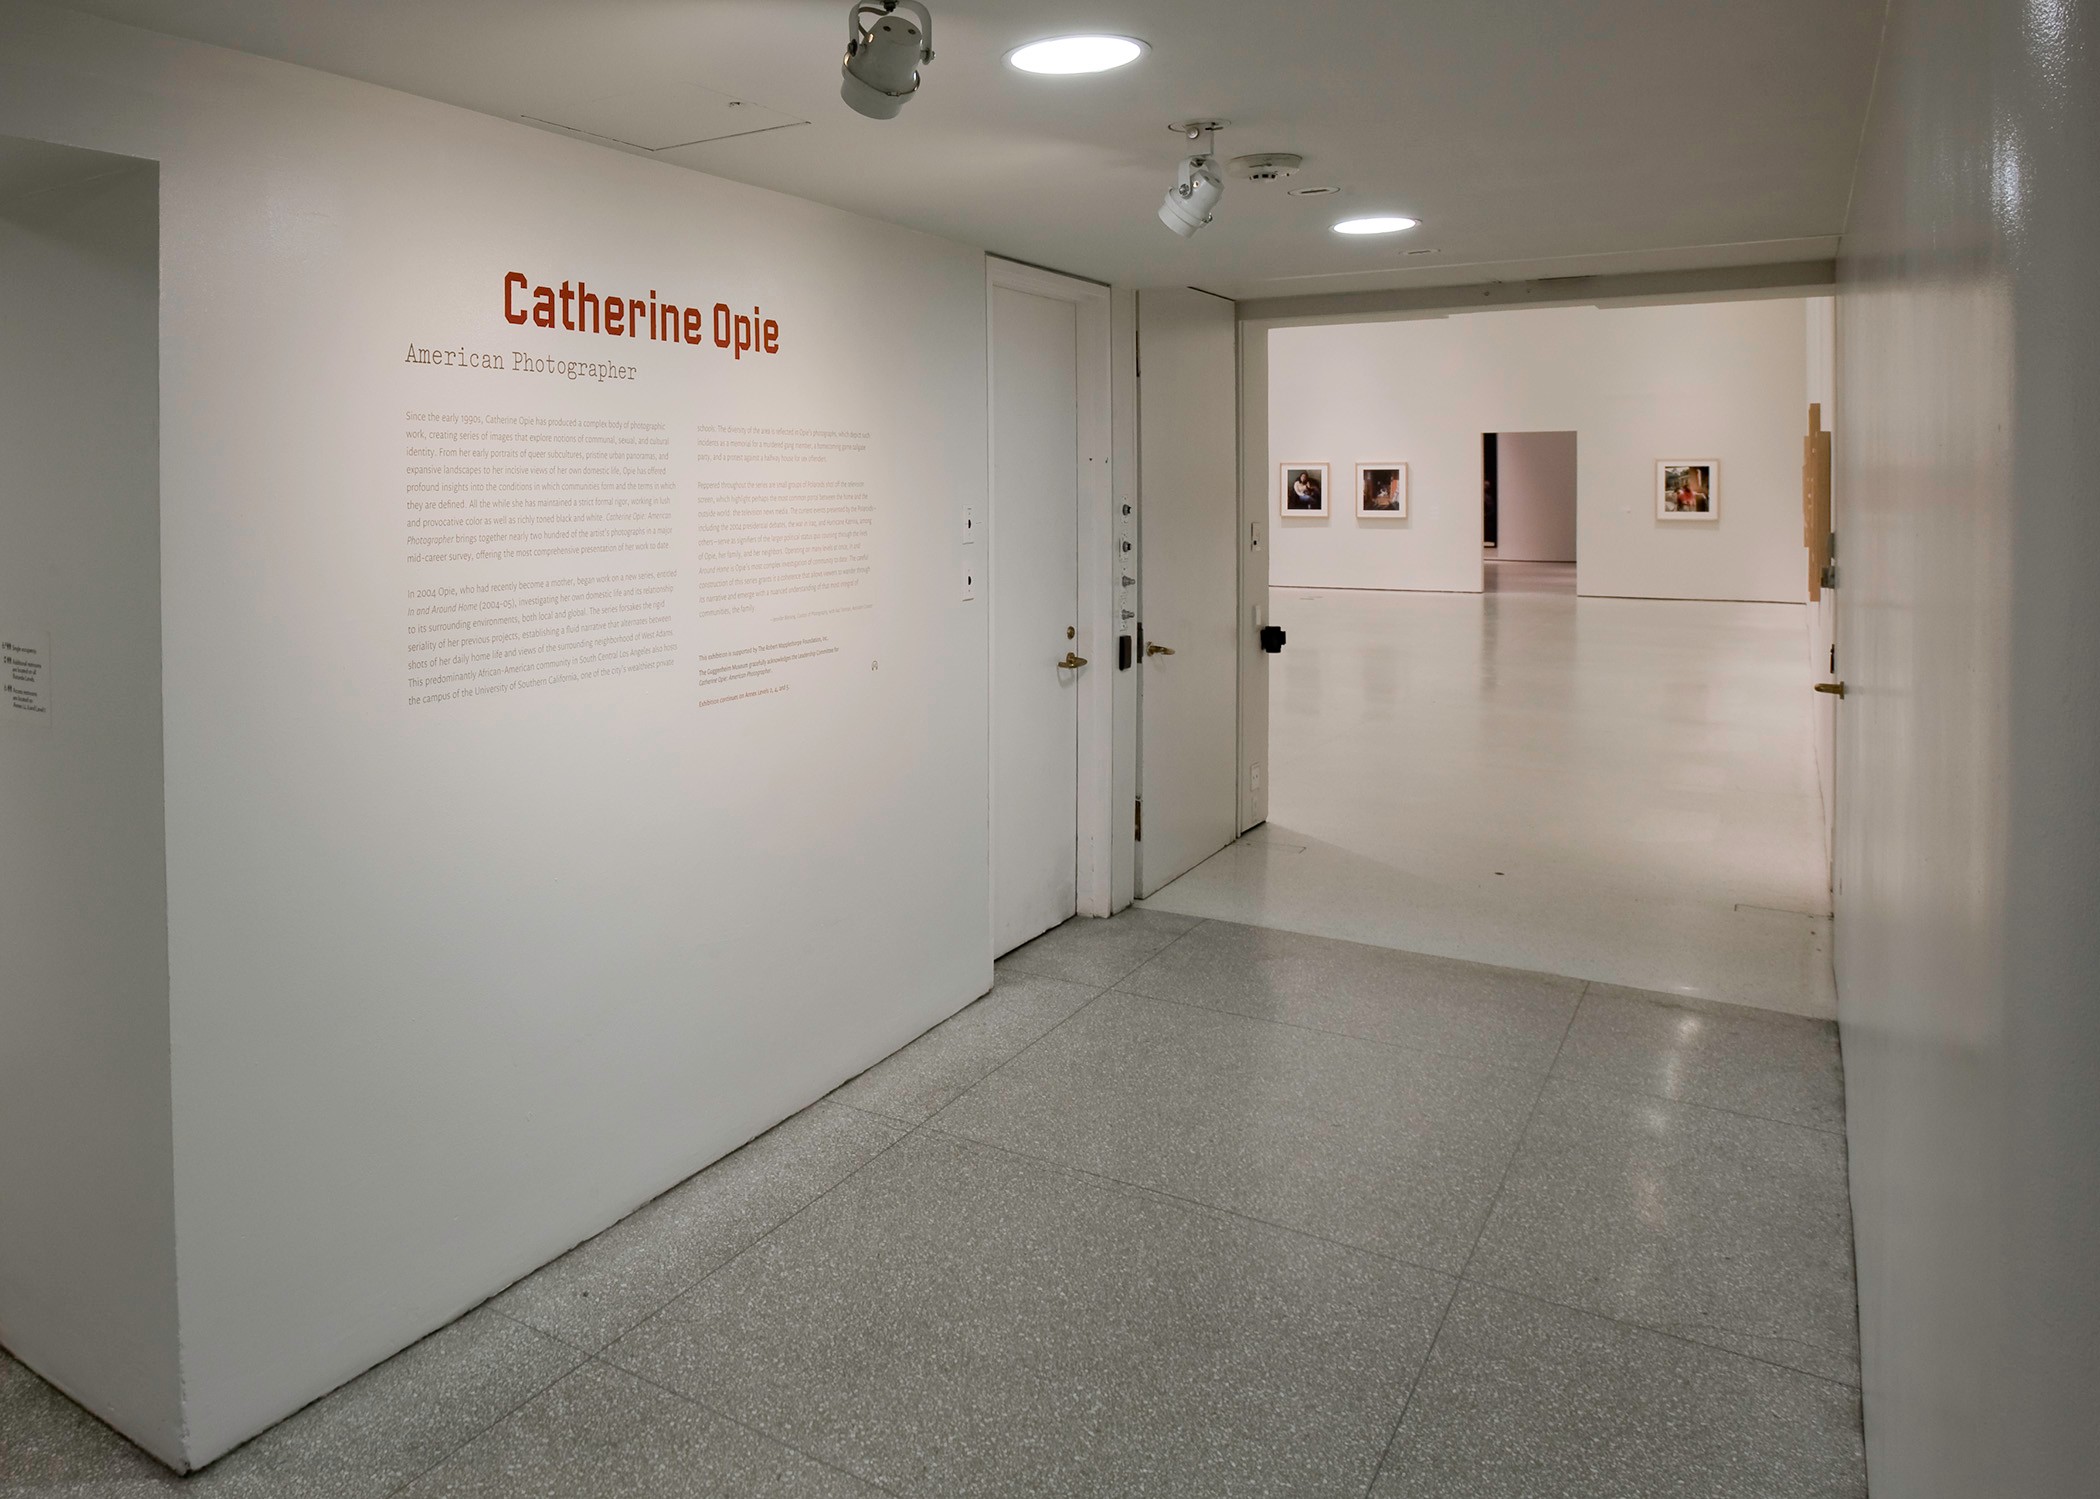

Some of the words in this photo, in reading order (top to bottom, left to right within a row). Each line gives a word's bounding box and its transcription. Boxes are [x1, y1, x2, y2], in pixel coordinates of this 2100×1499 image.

[503, 271, 702, 345] Catherine
[713, 303, 780, 361] Opie
[405, 343, 505, 370] American
[512, 351, 637, 382] Photographer
[406, 411, 426, 421] Since
[428, 412, 440, 422] the
[442, 413, 459, 425] early
[461, 414, 483, 426] 1990s,
[486, 414, 517, 425] Catherine
[519, 416, 534, 428] Opie
[536, 416, 546, 426] has
[548, 417, 576, 429] produced
[406, 429, 426, 440] work,
[429, 430, 458, 442] creating
[460, 430, 479, 440] series
[481, 431, 488, 440] of
[490, 431, 513, 444] images
[515, 432, 528, 441] that
[530, 433, 552, 445] explore
[554, 433, 576, 443] notions
[407, 446, 437, 459] identity.
[439, 446, 457, 456] From
[459, 447, 470, 457] her
[473, 447, 489, 460] early
[491, 448, 518, 460] portraits
[520, 448, 527, 457] of
[528, 452, 546, 460] queer
[407, 464, 441, 477] expansive
[444, 464, 481, 477] landscapes
[492, 465, 503, 474] her
[505, 465, 528, 474] incisive
[530, 465, 547, 474] views
[549, 465, 556, 474] of
[557, 465, 567, 474] her
[407, 481, 439, 495] profound
[442, 481, 468, 494] insights
[471, 481, 484, 491] into
[486, 481, 497, 491] the
[499, 481, 532, 491] conditions
[534, 481, 540, 490] in
[542, 481, 560, 490] which
[407, 499, 423, 512] they
[438, 498, 467, 509] defined.
[469, 498, 477, 508] All
[480, 498, 490, 508] the
[492, 498, 510, 508] while
[512, 498, 523, 507] she
[525, 498, 536, 507] has
[538, 497, 572, 507] maintained
[407, 517, 421, 527] and
[423, 516, 463, 530] provocative
[466, 515, 482, 525] color
[494, 514, 507, 524] well
[518, 514, 535, 526] richly
[537, 513, 554, 523] toned
[556, 513, 572, 522] black
[407, 534, 454, 547] Photographer
[456, 533, 477, 545] brings
[479, 532, 507, 545] together
[509, 531, 528, 543] nearly
[530, 532, 542, 540] two
[544, 529, 569, 539] hundred
[407, 552, 447, 563] mid-career
[449, 553, 474, 562] survey,
[476, 548, 502, 561] offering
[504, 548, 514, 557] the
[516, 549, 532, 557] most
[408, 588, 415, 599] In
[417, 590, 436, 600] 2004
[438, 585, 457, 599] Opie,
[460, 584, 475, 594] who
[477, 582, 489, 593] had
[491, 581, 517, 593] recently
[519, 580, 544, 590] become
[408, 606, 414, 616] In
[417, 604, 430, 615] and
[432, 602, 457, 614] Around
[458, 601, 477, 612] Home
[519, 594, 558, 607] investigating
[560, 593, 570, 602] her
[408, 626, 416, 634] to
[418, 623, 427, 633] its
[429, 619, 471, 632] surrounding
[473, 616, 519, 628] environments,
[522, 612, 537, 622] both
[539, 610, 553, 621] local
[555, 609, 566, 619] and
[408, 640, 436, 653] seriality
[438, 638, 445, 649] of
[448, 637, 459, 648] her
[461, 634, 490, 649] previous
[522, 626, 559, 639] establishing
[408, 659, 427, 670] shots
[430, 656, 437, 667] of
[439, 655, 450, 666] her
[453, 653, 469, 666] daily
[471, 652, 490, 662] home
[492, 649, 502, 659] life
[504, 647, 516, 658] and
[518, 646, 536, 656] views
[538, 643, 544, 653] of
[546, 642, 556, 652] the
[408, 676, 423, 688] This
[426, 669, 476, 689] predominantly
[478, 663, 535, 678] African-American
[536, 657, 571, 670] community
[409, 695, 421, 706] the
[423, 693, 450, 705] campus
[452, 688, 460, 700] of
[462, 687, 473, 698] the
[475, 682, 508, 696] University
[510, 680, 516, 691] of
[518, 677, 547, 690] Southern
